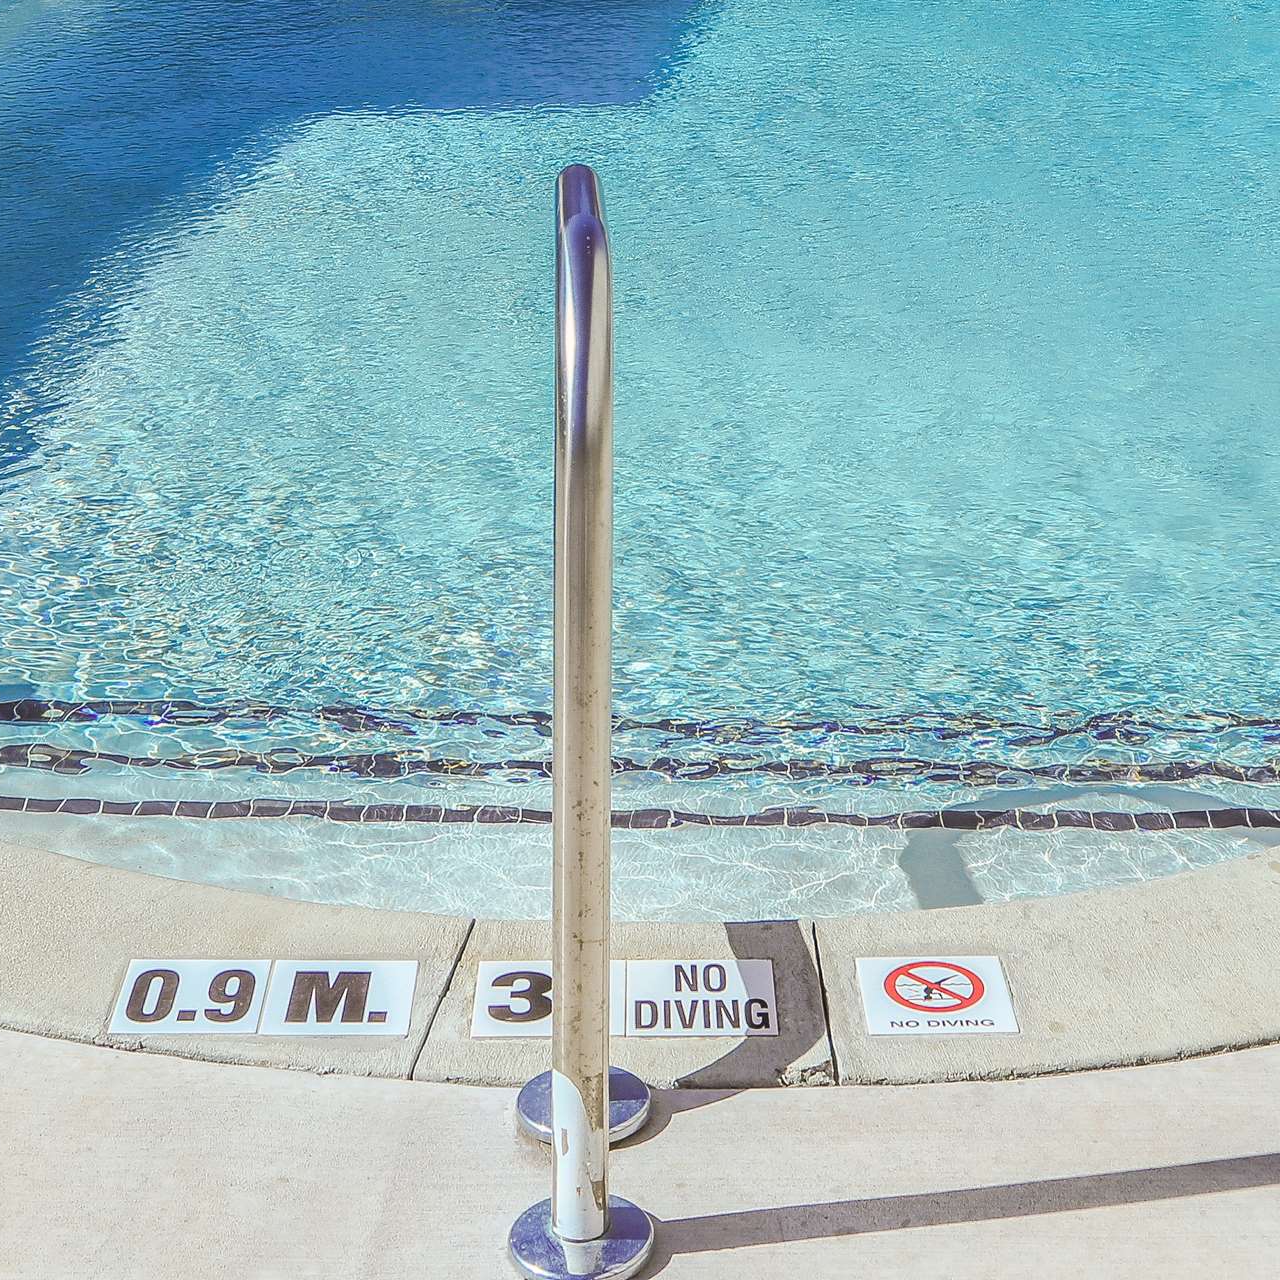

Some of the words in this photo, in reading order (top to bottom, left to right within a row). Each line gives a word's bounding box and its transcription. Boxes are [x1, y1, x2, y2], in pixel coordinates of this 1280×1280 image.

[674, 963, 727, 993] NO
[125, 969, 256, 1023] 0.9
[284, 971, 388, 1023] M.
[488, 971, 552, 1023] 3
[634, 998, 771, 1029] DIVING
[890, 1020, 919, 1028] NO
[927, 1019, 995, 1028] DIVING
